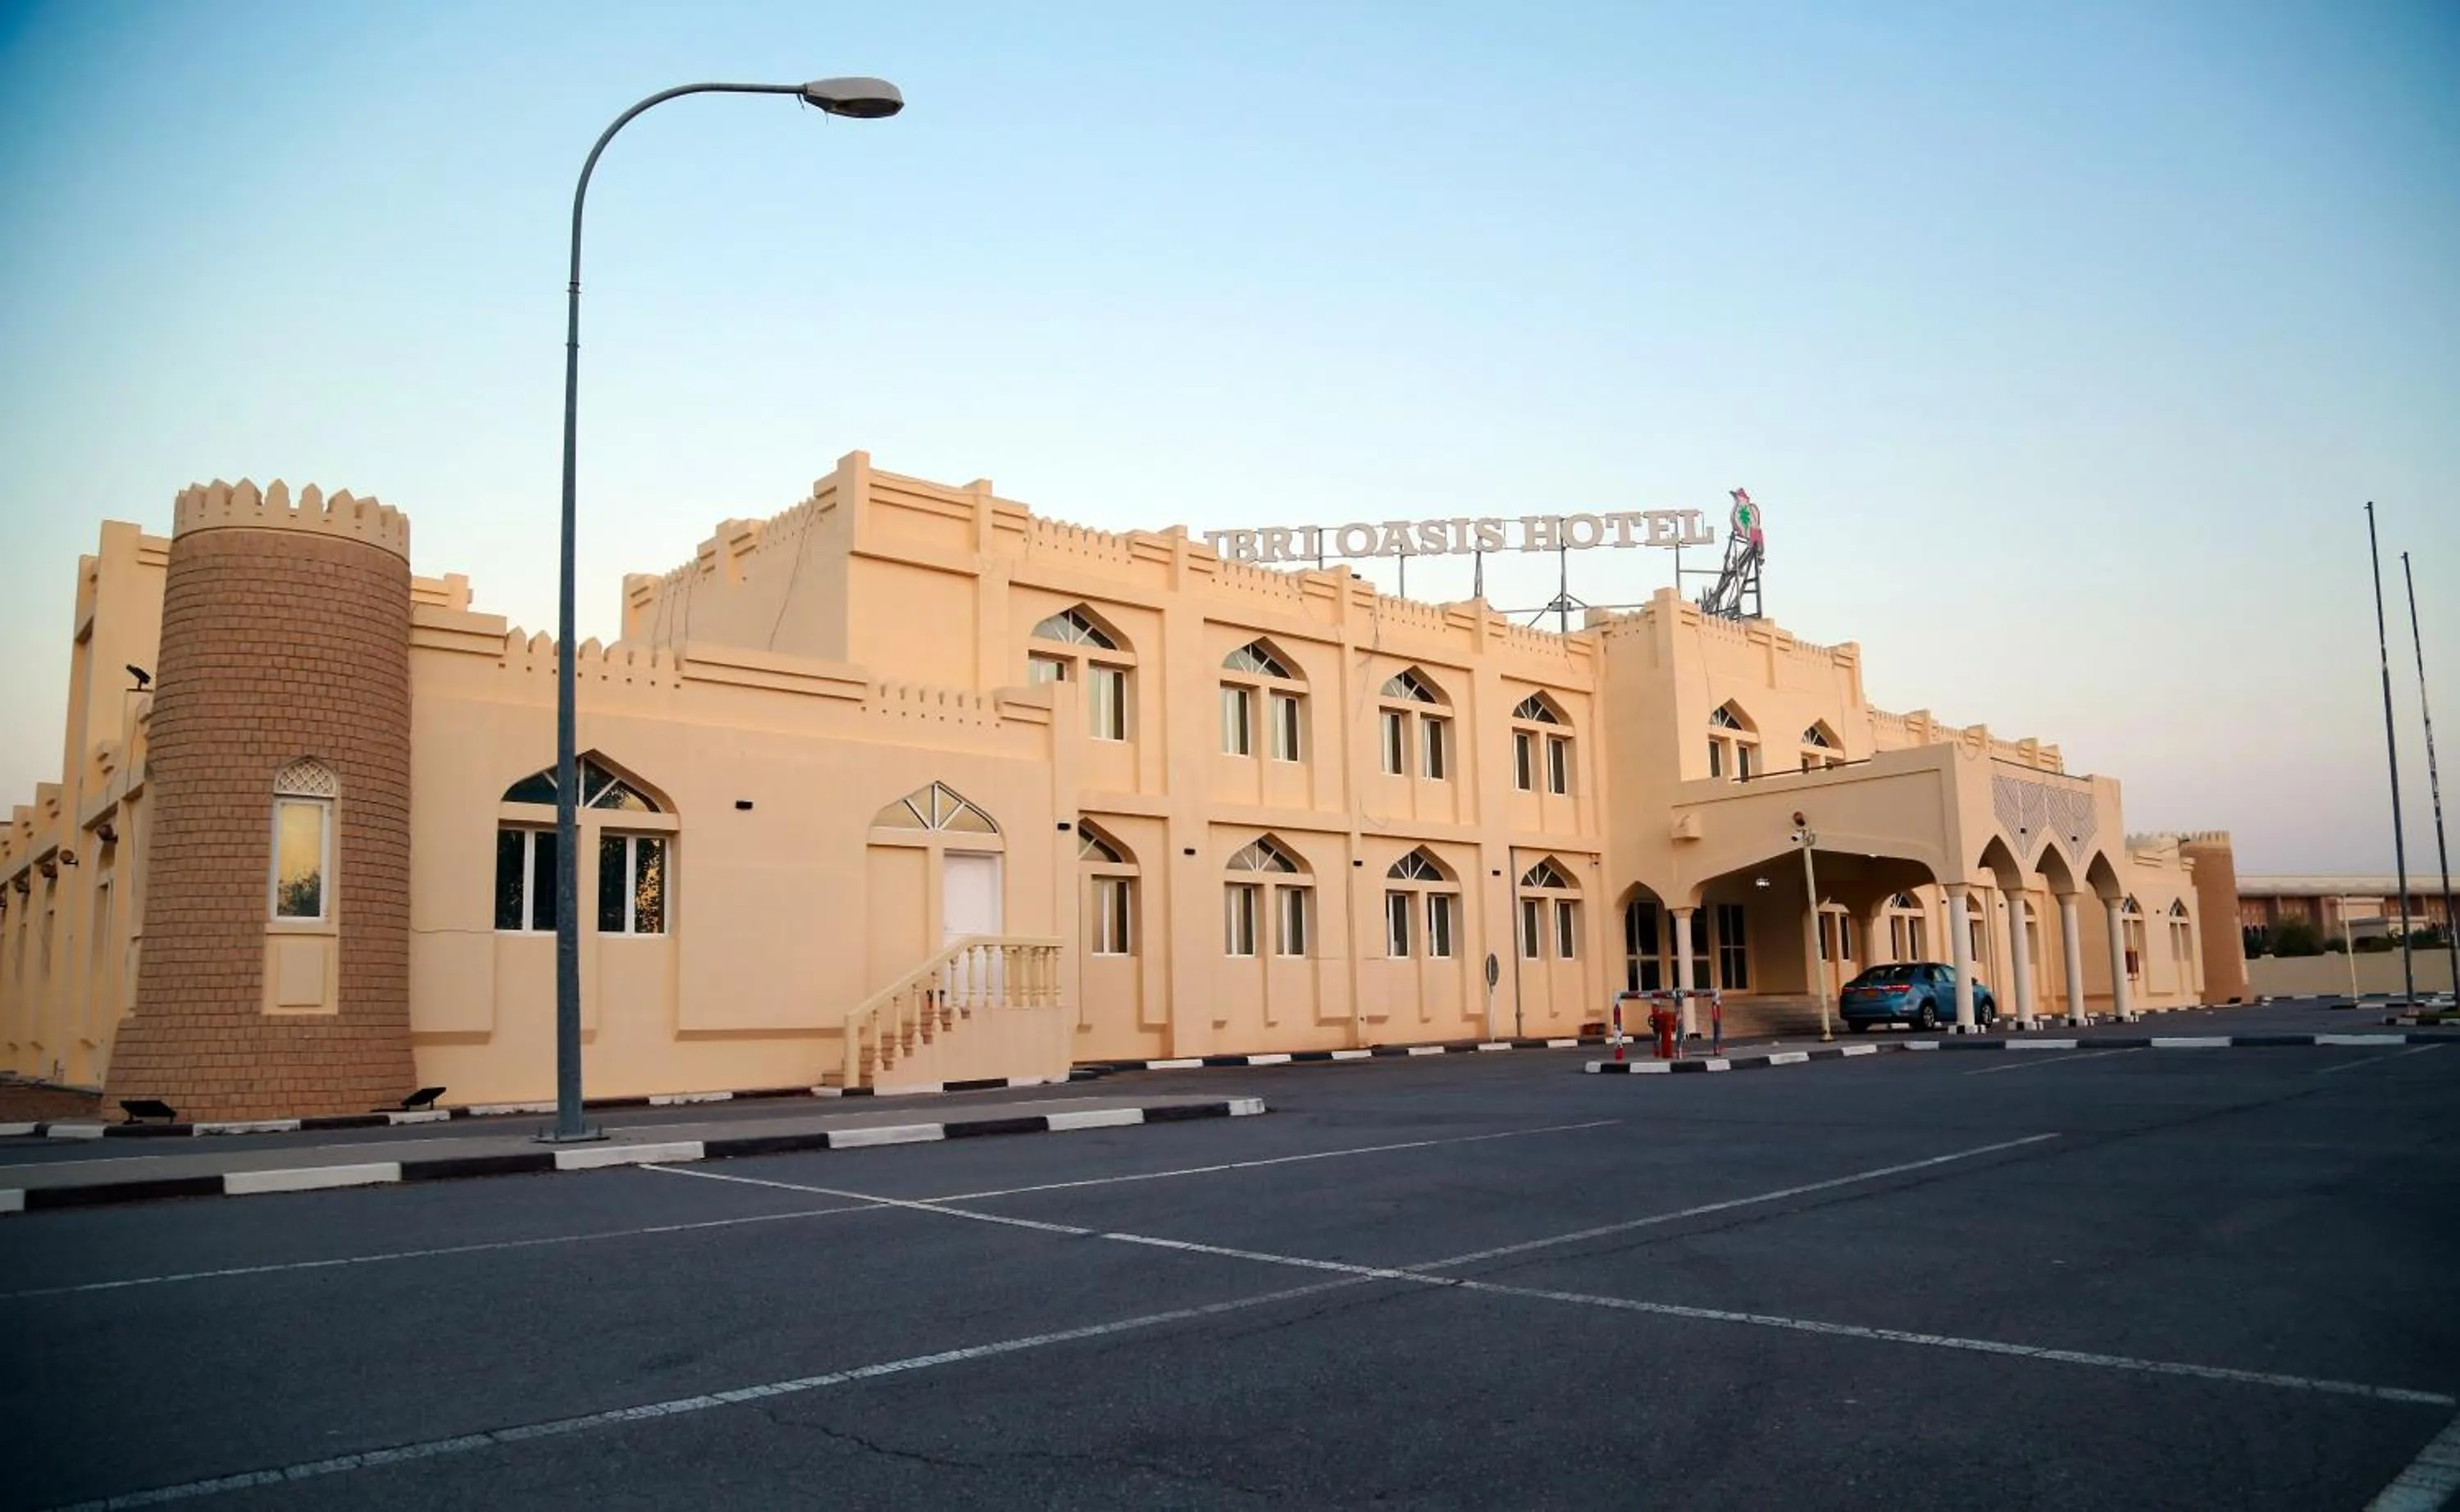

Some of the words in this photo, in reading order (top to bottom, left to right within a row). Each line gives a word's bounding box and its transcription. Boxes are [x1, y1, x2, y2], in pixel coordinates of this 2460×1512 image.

[1203, 526, 1319, 562] IBRI
[1336, 517, 1504, 558] OASIS
[1519, 508, 1715, 552] HOTEL
